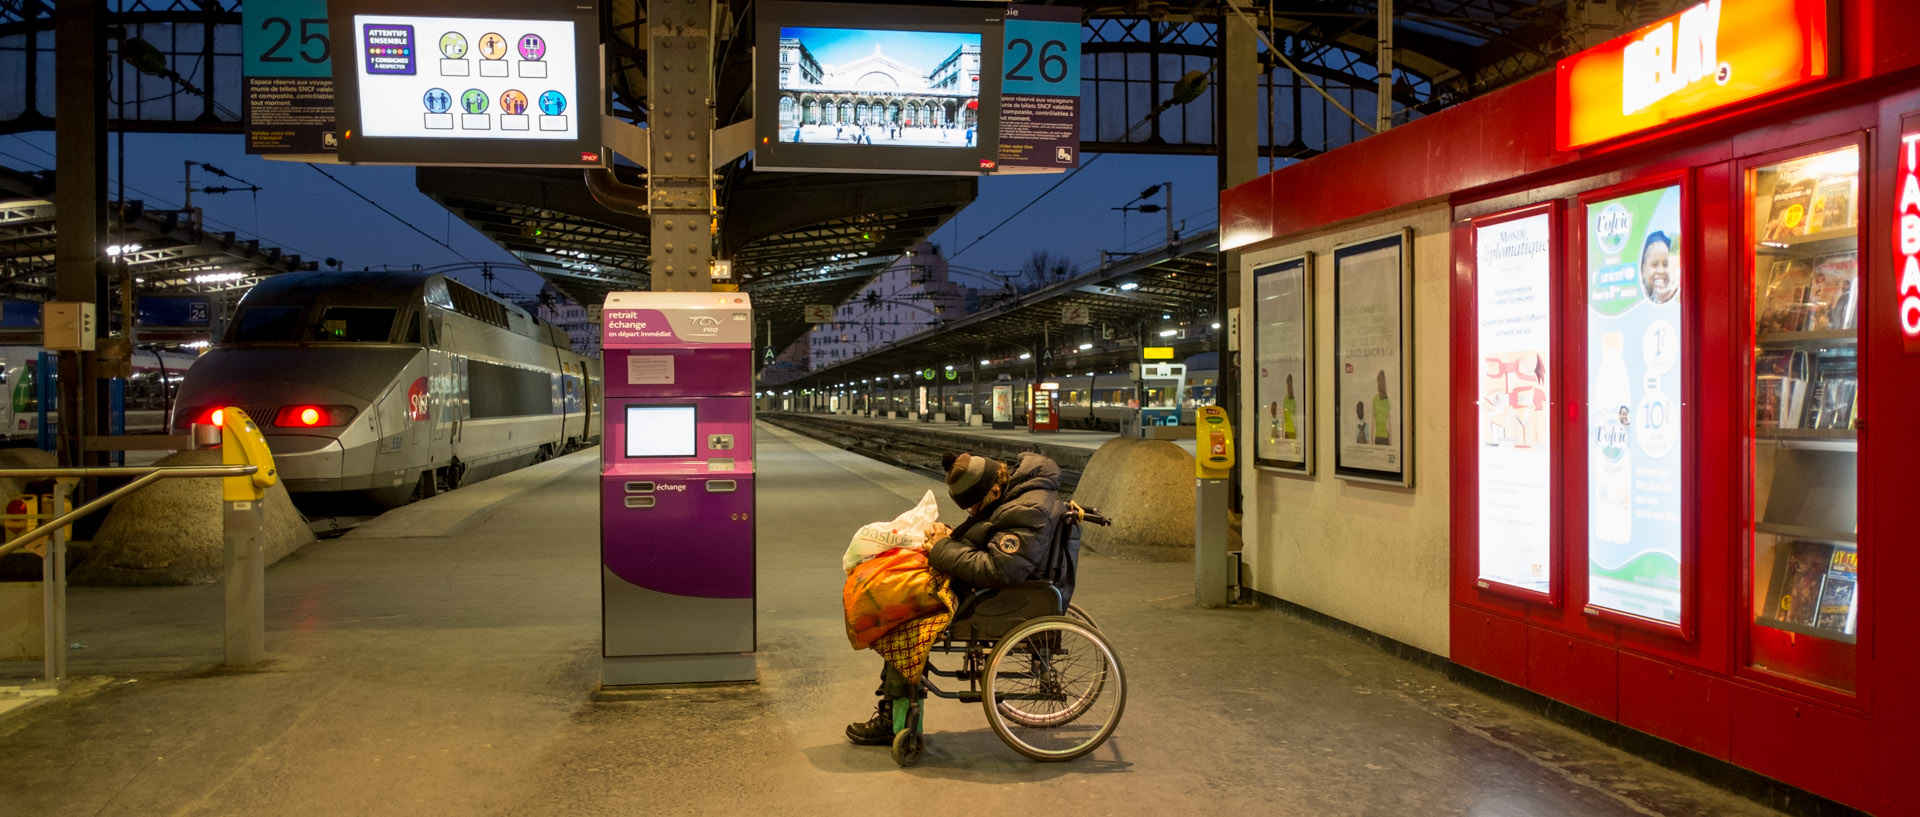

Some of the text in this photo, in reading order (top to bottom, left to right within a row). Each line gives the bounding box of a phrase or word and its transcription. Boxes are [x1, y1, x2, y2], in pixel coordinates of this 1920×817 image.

[1006, 7, 1019, 16] oie
[260, 17, 330, 64] 25
[1005, 38, 1068, 83] 26
[1597, 212, 1630, 233] Volvic
[1901, 133, 1920, 337] TABAC
[192, 309, 206, 319] 24
[609, 320, 646, 330] échange
[688, 316, 727, 326] TGV
[765, 348, 774, 358] A
[1043, 350, 1052, 360] A
[656, 484, 686, 492] échange
